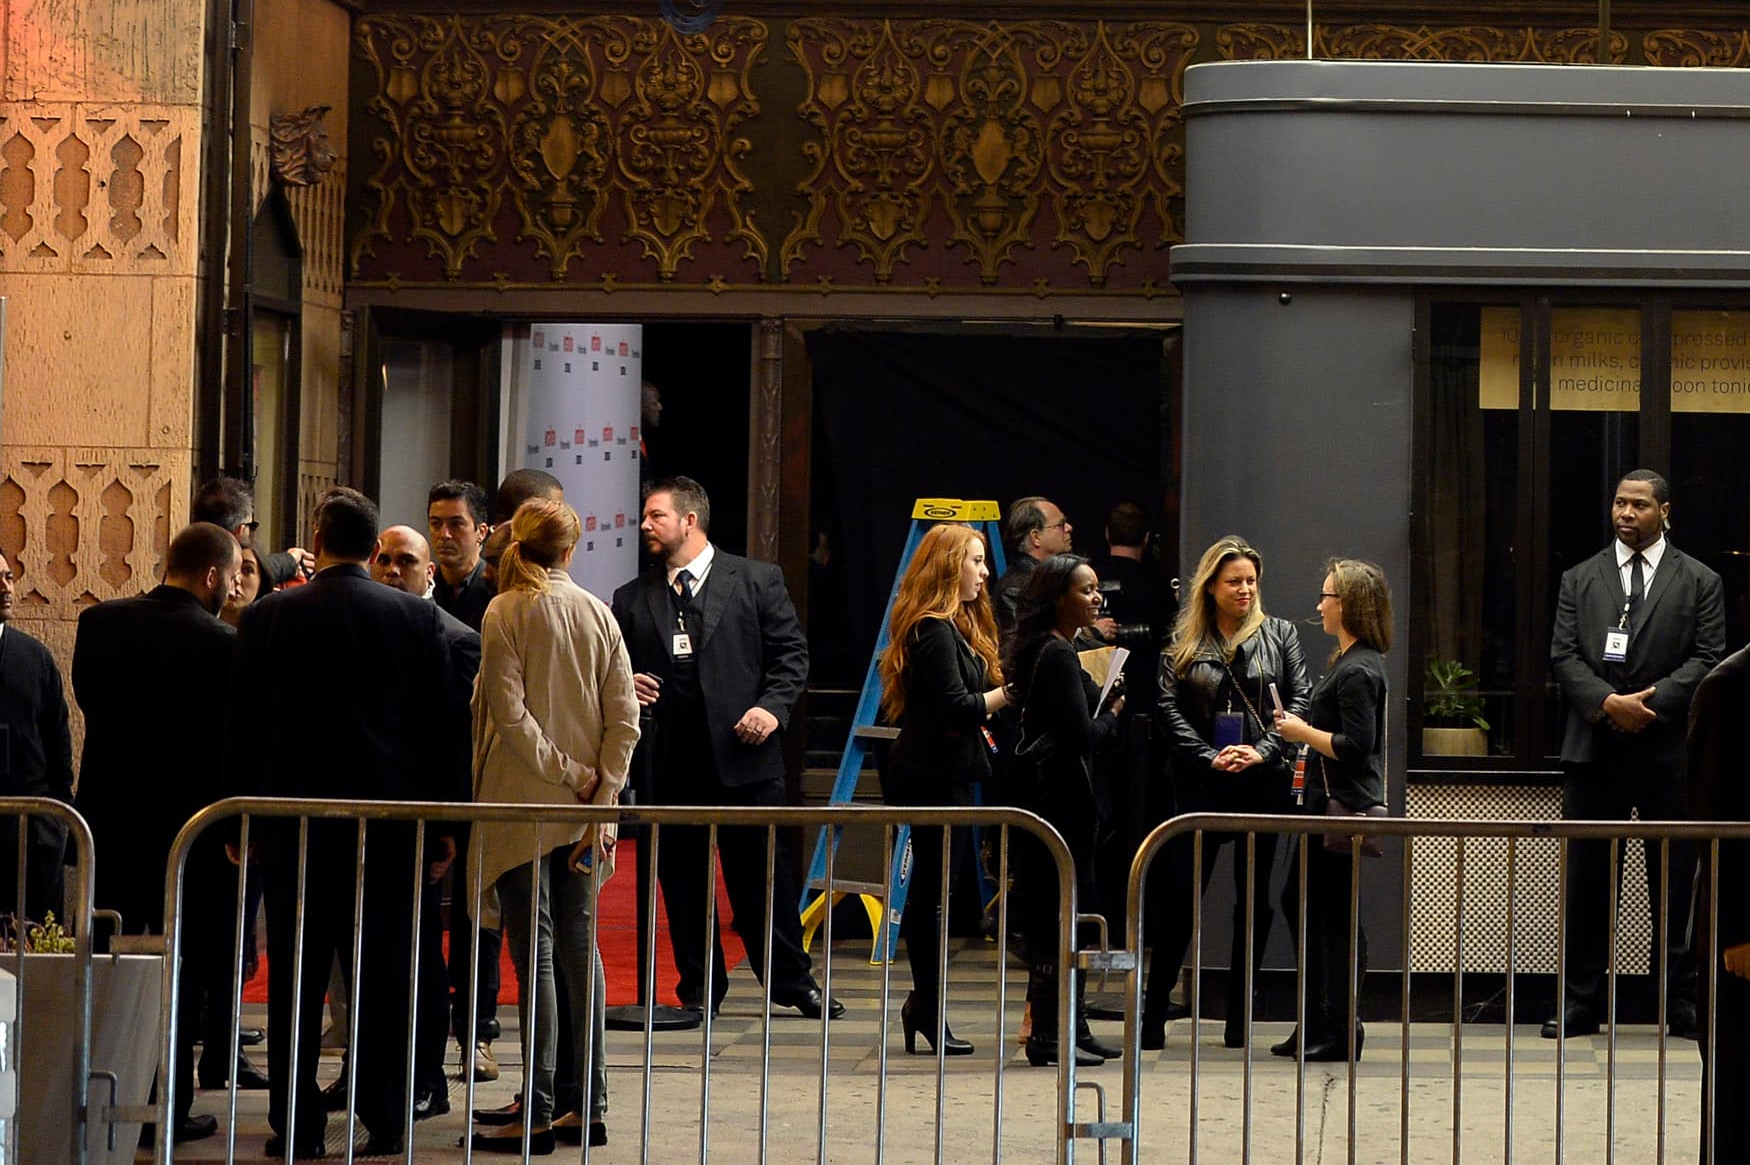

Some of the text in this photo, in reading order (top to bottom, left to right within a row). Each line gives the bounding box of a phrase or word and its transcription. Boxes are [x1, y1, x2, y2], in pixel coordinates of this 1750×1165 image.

[1570, 352, 1624, 370] milks,
[1559, 376, 1641, 393] medicina
[1672, 380, 1706, 394] oon
